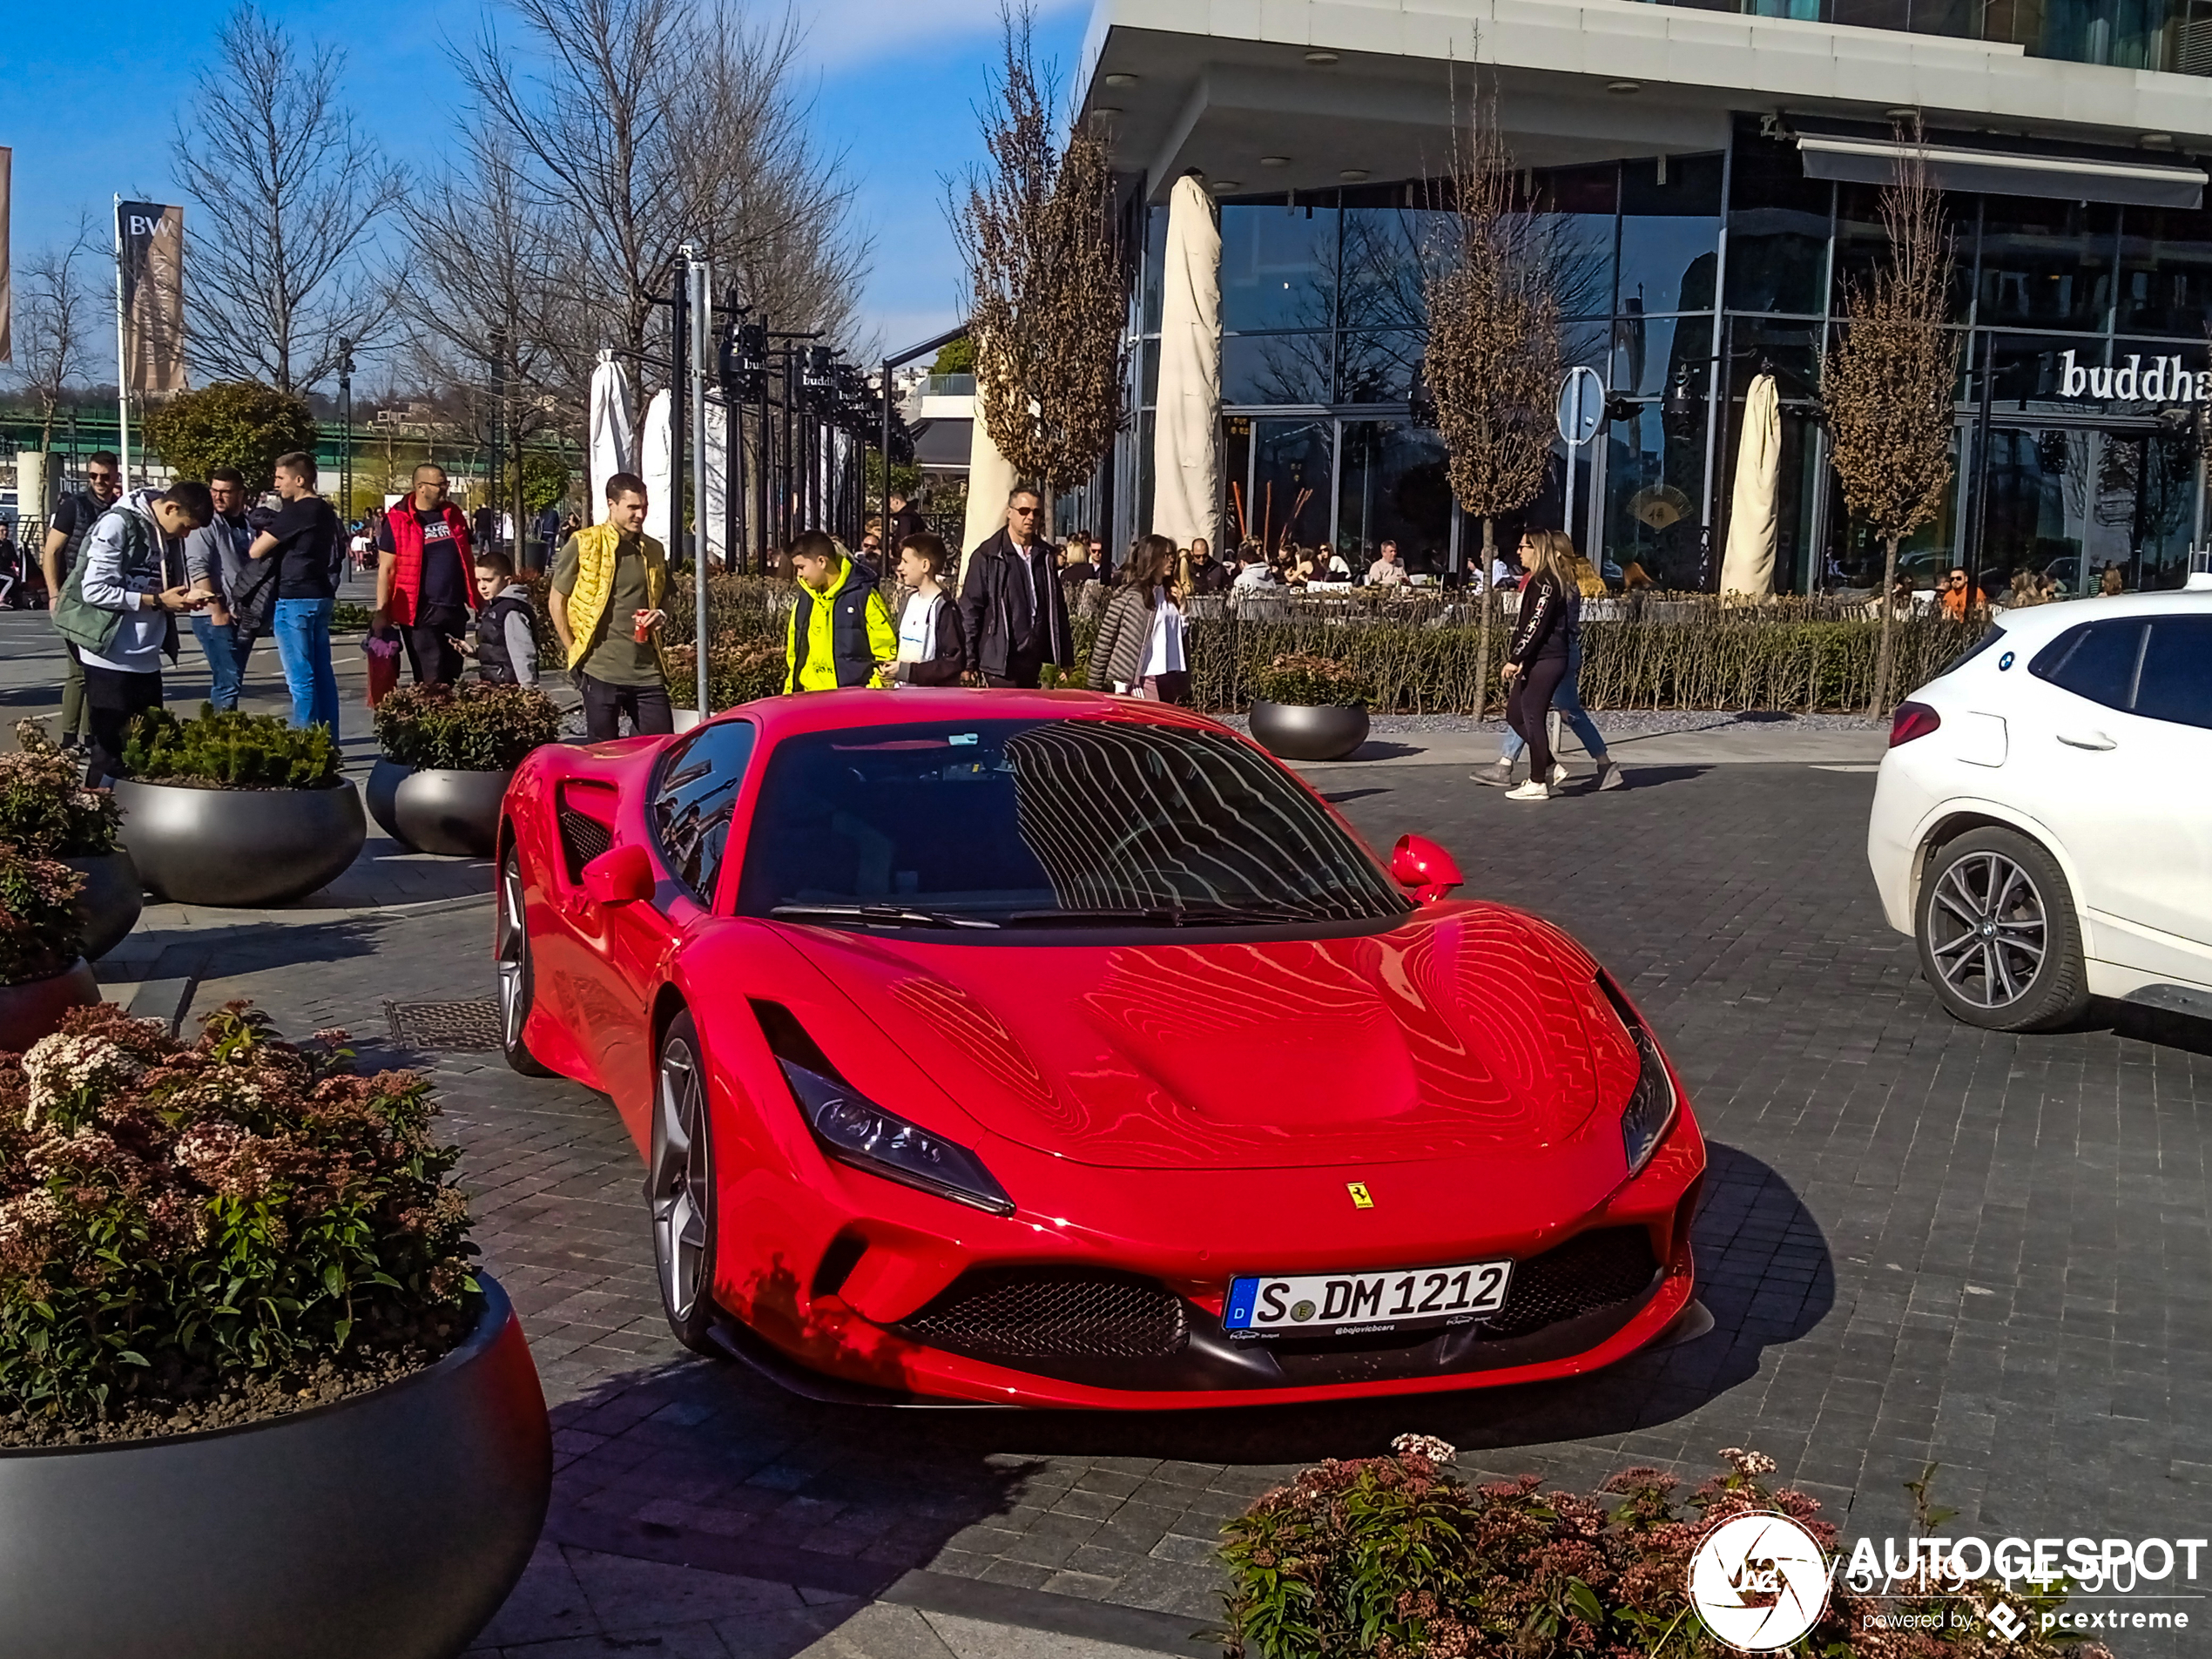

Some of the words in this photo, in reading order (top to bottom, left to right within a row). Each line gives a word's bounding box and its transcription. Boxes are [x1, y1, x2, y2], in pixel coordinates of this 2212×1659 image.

[130, 215, 172, 237] BW
[1258, 1283, 1291, 1322] S
[1318, 1278, 1385, 1319] DM
[1389, 1268, 1503, 1315] 1212
[1233, 1308, 1245, 1319] D
